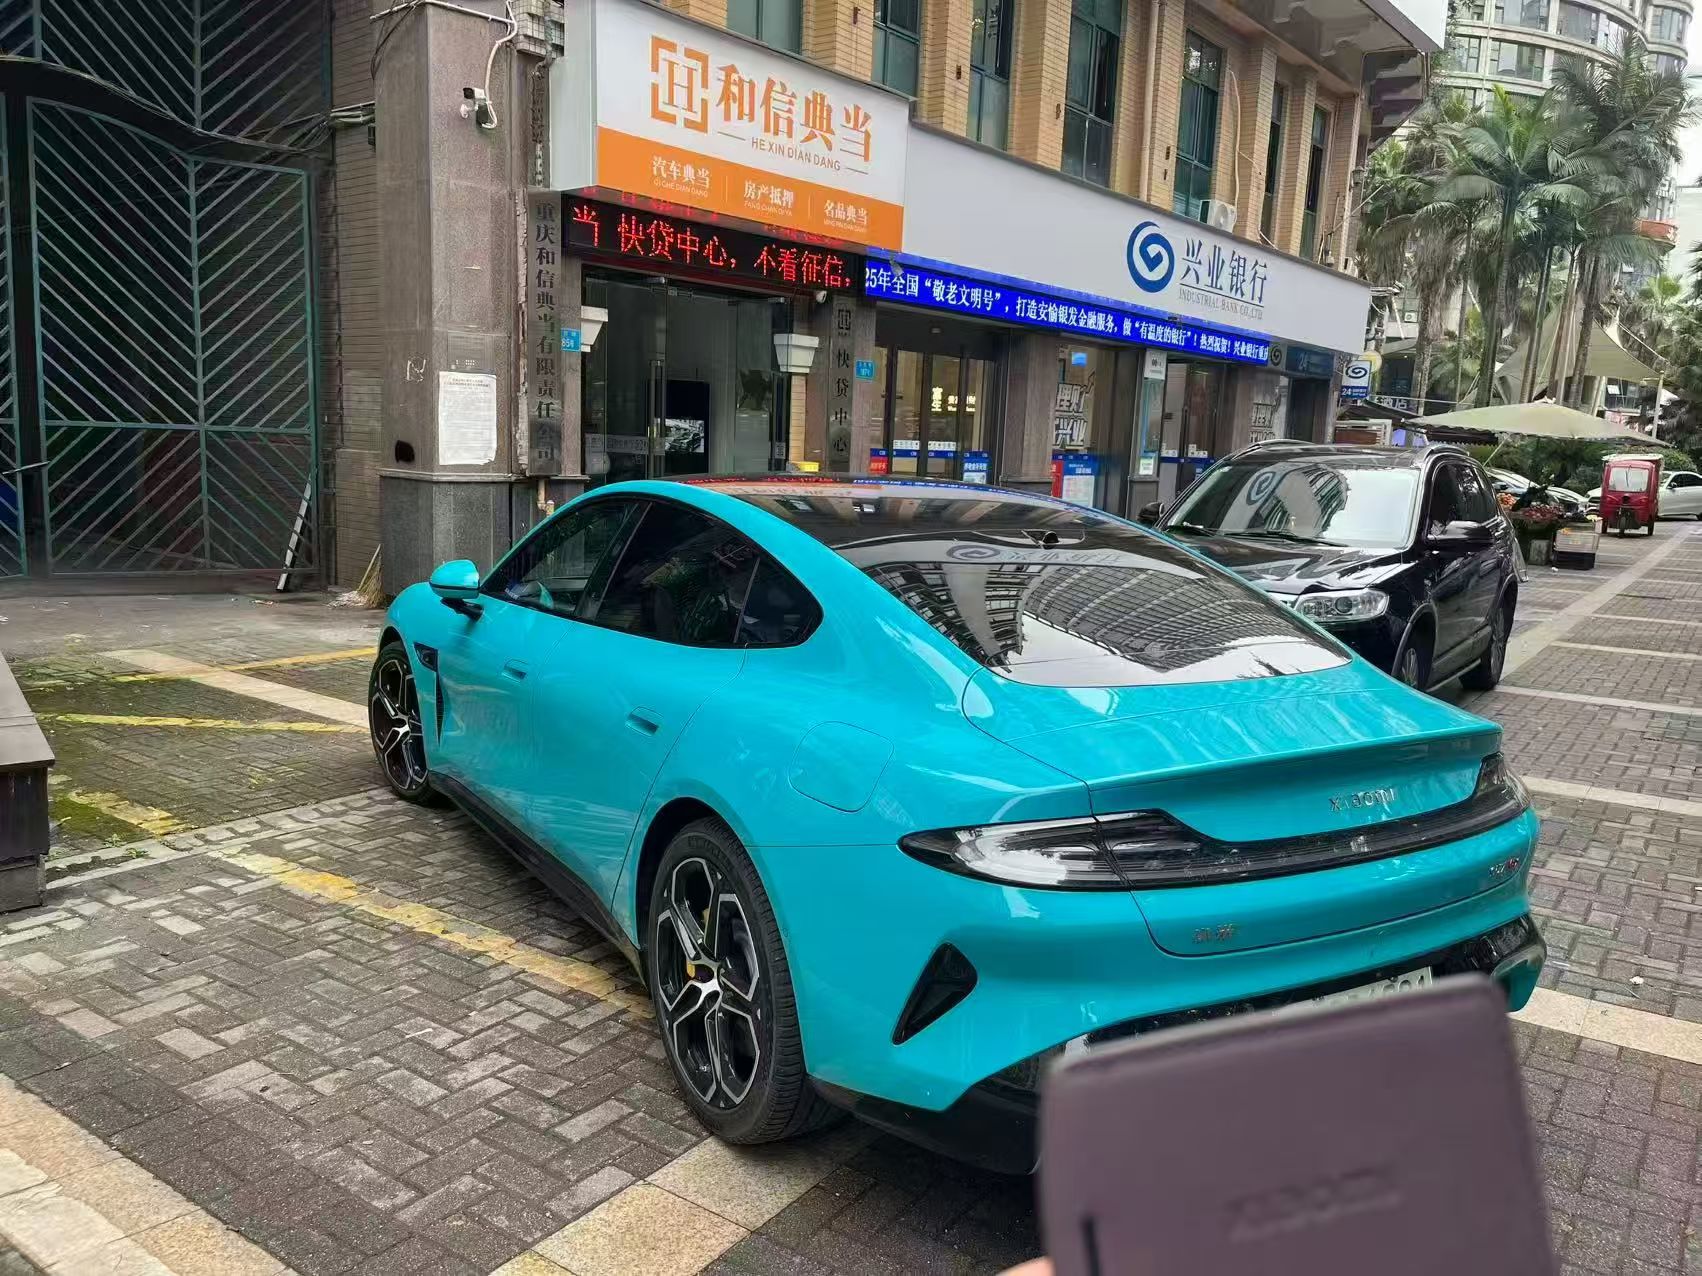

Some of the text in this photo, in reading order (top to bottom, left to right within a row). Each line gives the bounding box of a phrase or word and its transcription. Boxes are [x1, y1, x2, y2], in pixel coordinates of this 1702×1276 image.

[715, 63, 873, 163] 和信典当
[751, 136, 842, 172] HE XIN DIAN DANG
[652, 155, 710, 189] 汽车典当
[743, 180, 794, 208] 房产抵押
[823, 200, 868, 225] 名品典当
[1179, 236, 1268, 304] 兴业银行
[1178, 287, 1219, 310] INDUSTRIAL
[1221, 299, 1239, 315] BANK
[535, 202, 556, 460] 重庆和信典当有限责任公司
[832, 348, 850, 452] 快贷中心
[1341, 388, 1352, 396] 24
[1054, 417, 1087, 446] 兴业
